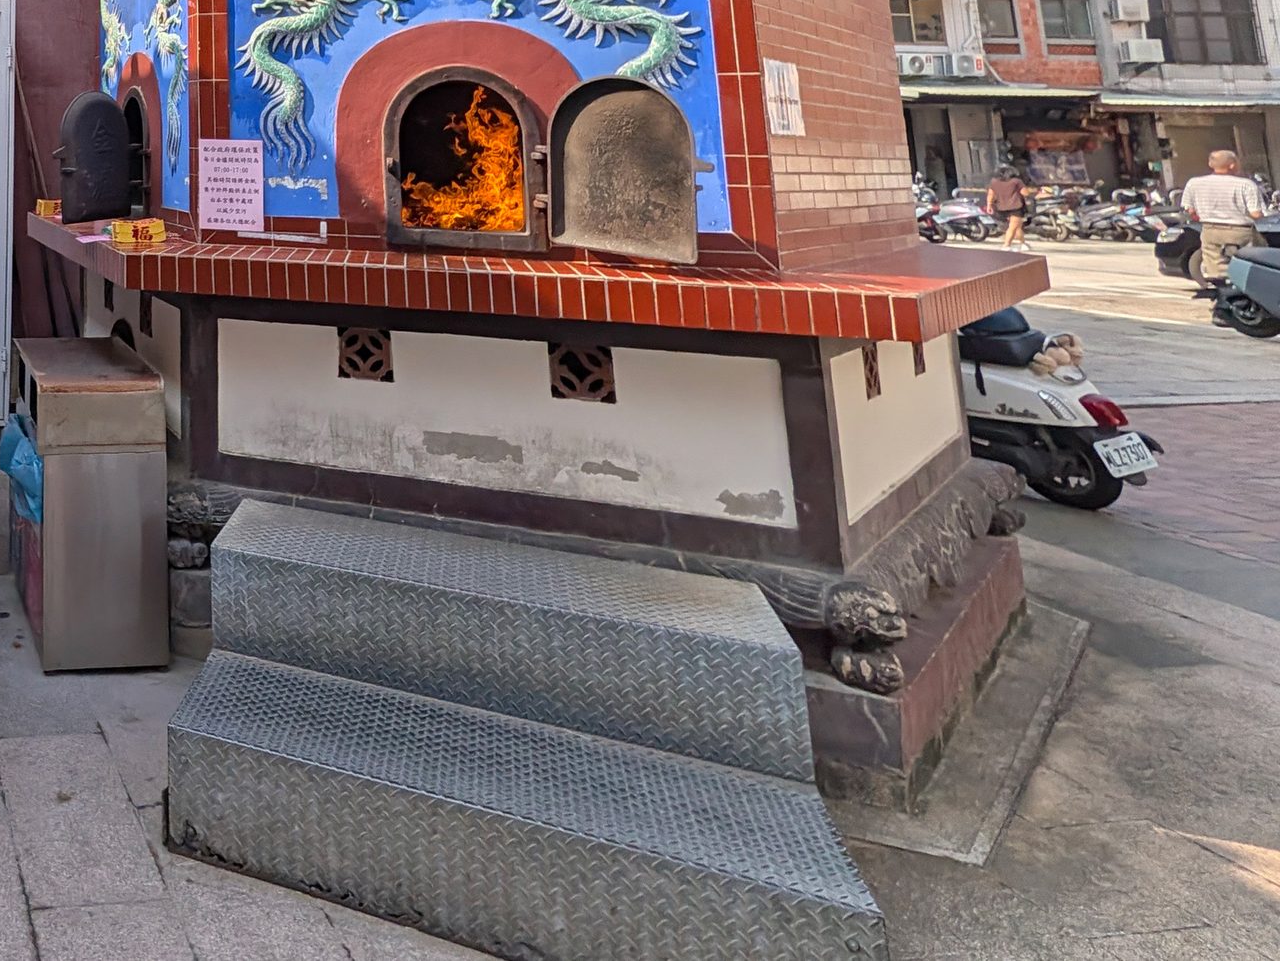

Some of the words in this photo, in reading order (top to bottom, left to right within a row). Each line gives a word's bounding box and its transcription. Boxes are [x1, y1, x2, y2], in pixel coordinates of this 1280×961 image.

[203, 146, 259, 154] 配合政府環保政策
[132, 225, 153, 241] 福
